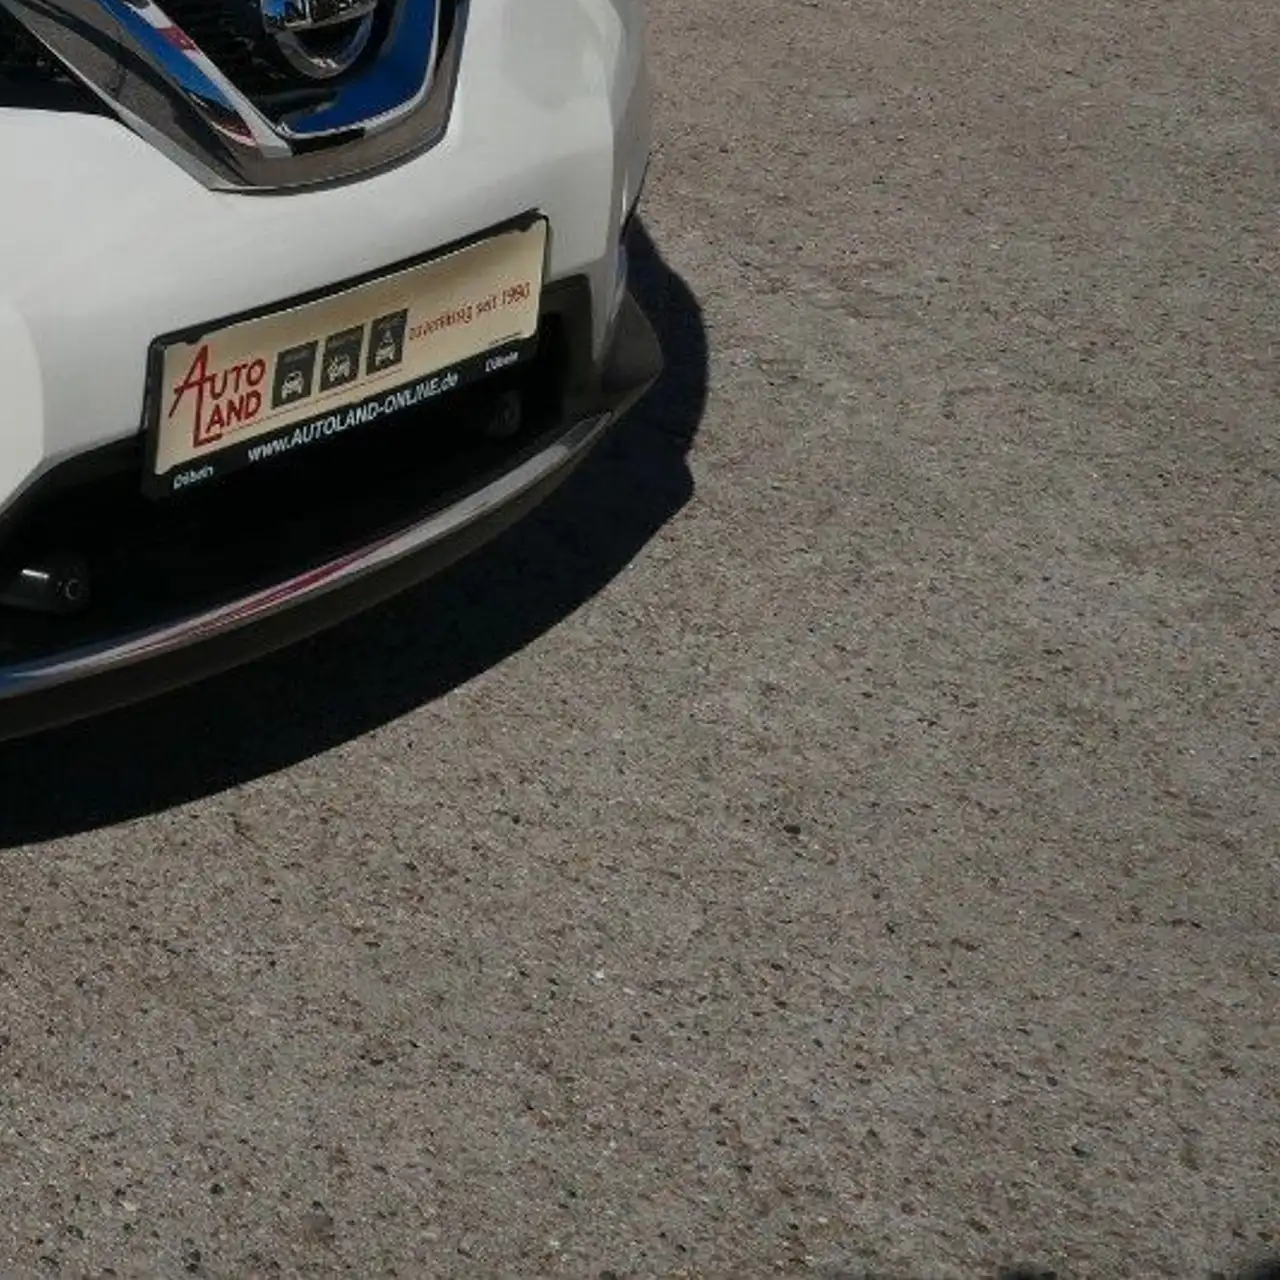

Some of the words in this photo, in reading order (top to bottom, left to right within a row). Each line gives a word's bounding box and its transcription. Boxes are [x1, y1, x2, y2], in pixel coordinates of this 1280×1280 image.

[168, 344, 267, 418] AUTO
[193, 388, 264, 448] LAND
[247, 370, 460, 463] www.AUTOLAND-ONLINE.de
